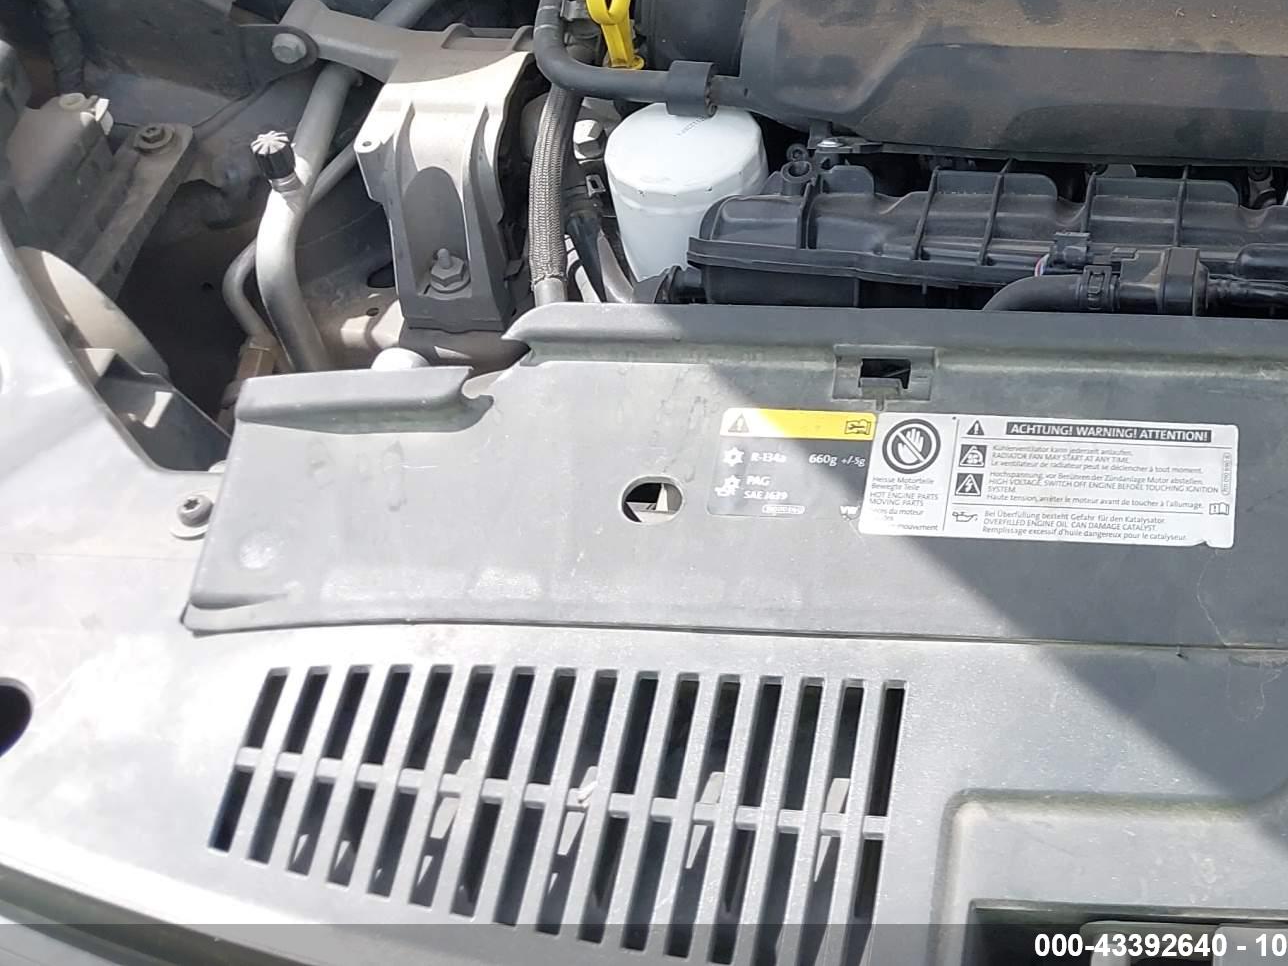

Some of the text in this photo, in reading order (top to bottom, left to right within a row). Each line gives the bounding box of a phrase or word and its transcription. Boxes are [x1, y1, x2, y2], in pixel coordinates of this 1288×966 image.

[1010, 423, 1208, 442] ACHTUNG! WARNING! ATTENTION!
[808, 453, 866, 468] 660g +/-5g
[745, 475, 772, 487] PAG
[988, 478, 1008, 486] HIGH
[1043, 479, 1073, 487] SWITCH
[1088, 481, 1116, 490] ENGINE
[1117, 483, 1144, 491] BEFORE
[1145, 484, 1184, 492] TOUCHING
[742, 490, 764, 499] SAE
[869, 491, 939, 501] HOT ENGINE PARTS
[868, 498, 924, 507] MOVING PARTS
[983, 518, 1026, 526] OVERFILLED
[1026, 519, 1054, 527] ENGINE
[1070, 521, 1087, 529] CAN
[1087, 522, 1121, 530] DAMAGE
[1109, 515, 1123, 523] den
